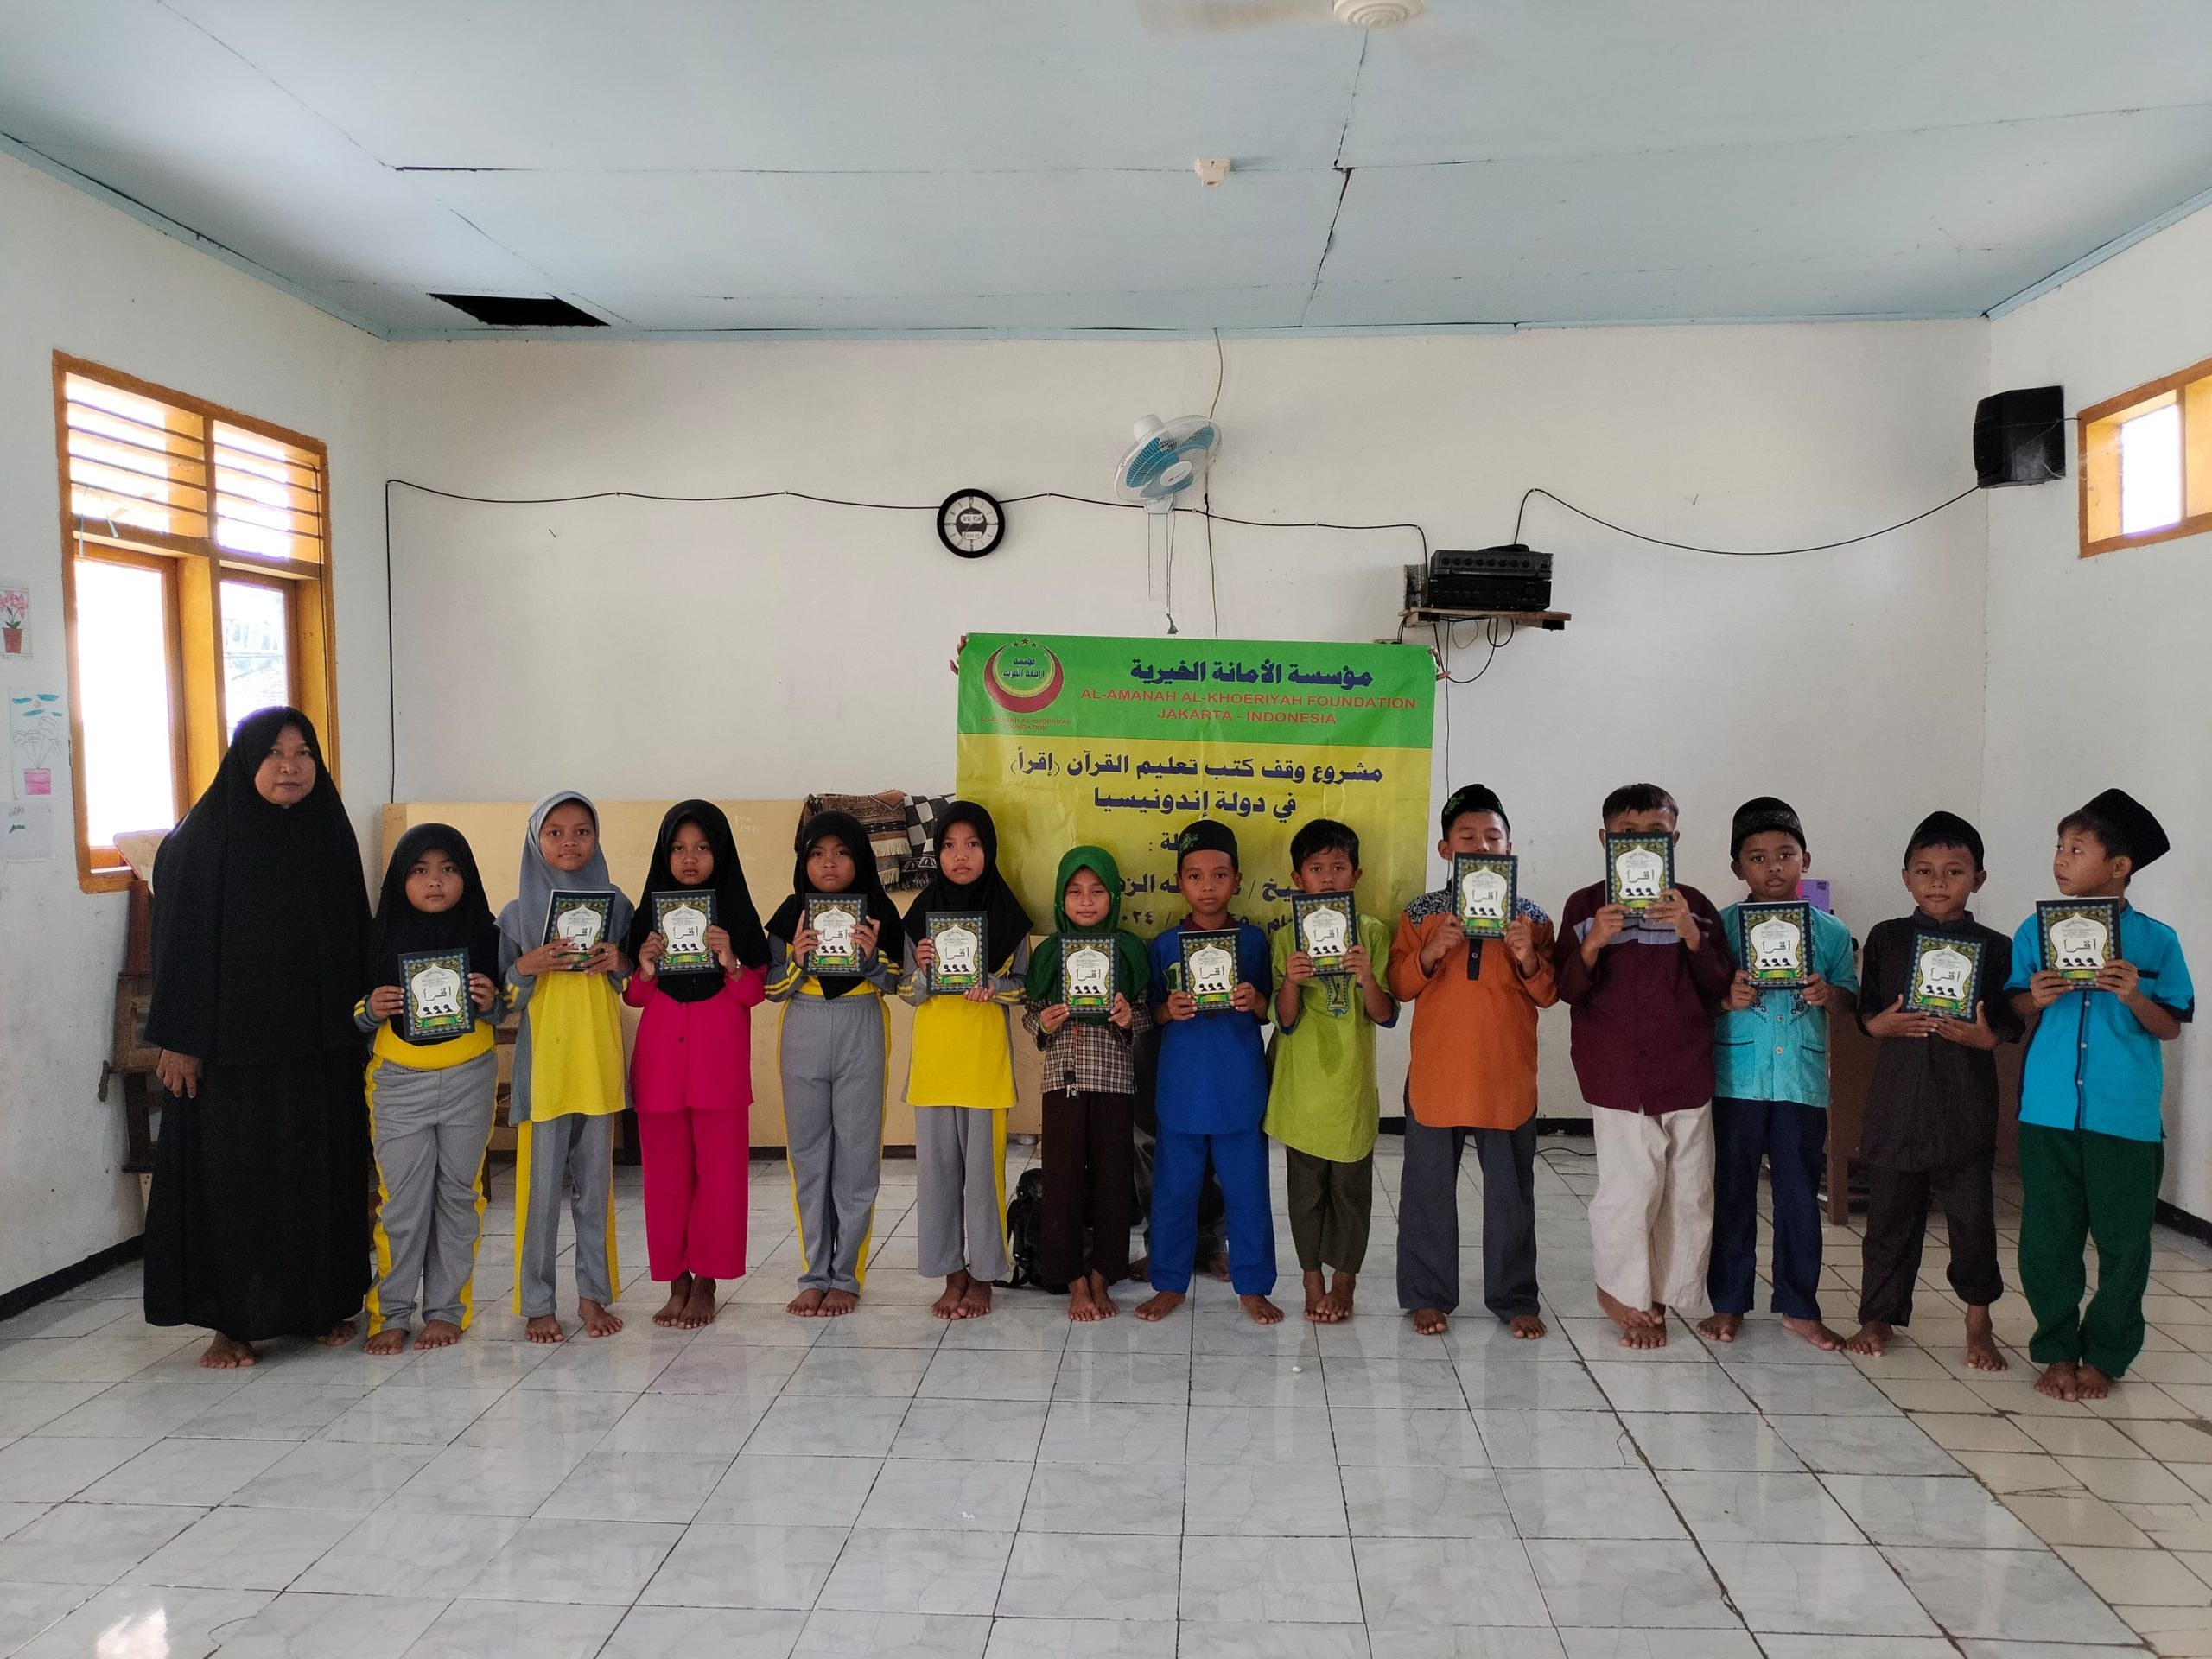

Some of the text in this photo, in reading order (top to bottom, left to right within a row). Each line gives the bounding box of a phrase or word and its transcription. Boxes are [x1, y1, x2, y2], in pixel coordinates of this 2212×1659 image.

[1130, 658, 1374, 690] مؤسسة الأمانة الخيرية
[1081, 689, 1416, 709] AL-AMANAH AL-KHOERIYAH FOUNDATION
[1157, 709, 1232, 721] JAKARTA
[1246, 710, 1337, 724] INDONESIA
[1067, 749, 1129, 777] القرآن
[1136, 756, 1198, 780] تعليم
[1205, 759, 1254, 780] كتب
[1262, 760, 1306, 784] وقف
[1312, 762, 1383, 785] مشروع
[1094, 786, 1296, 823] في دولة إندونيسيا
